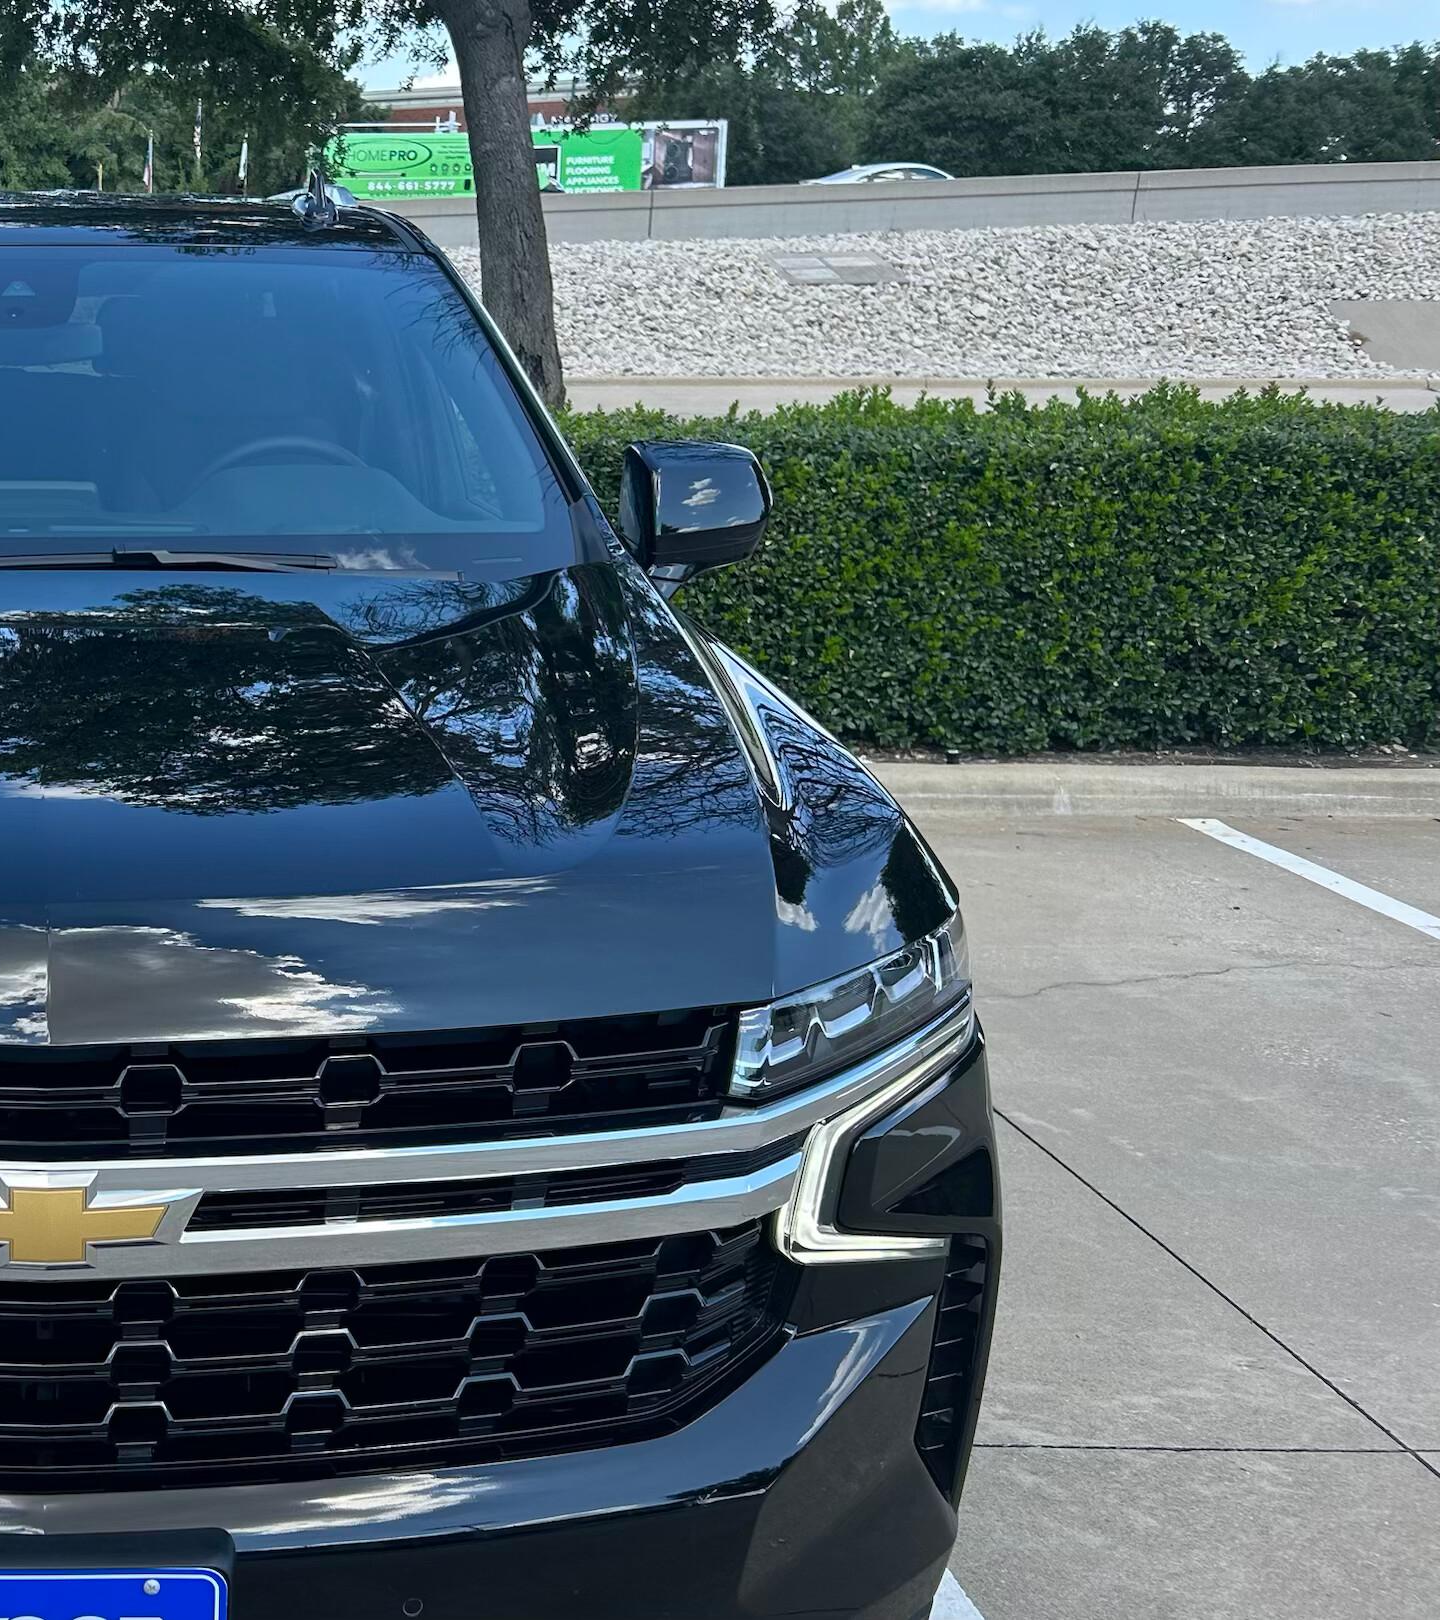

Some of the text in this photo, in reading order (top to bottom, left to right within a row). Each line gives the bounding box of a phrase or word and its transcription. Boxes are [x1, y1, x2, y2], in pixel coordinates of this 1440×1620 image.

[348, 150, 418, 161] HOMEPRO
[566, 156, 615, 165] FURNITURE
[566, 166, 611, 175] FLOORING
[566, 176, 619, 185] APPLIANCES
[368, 181, 457, 191] 844-661-5777
